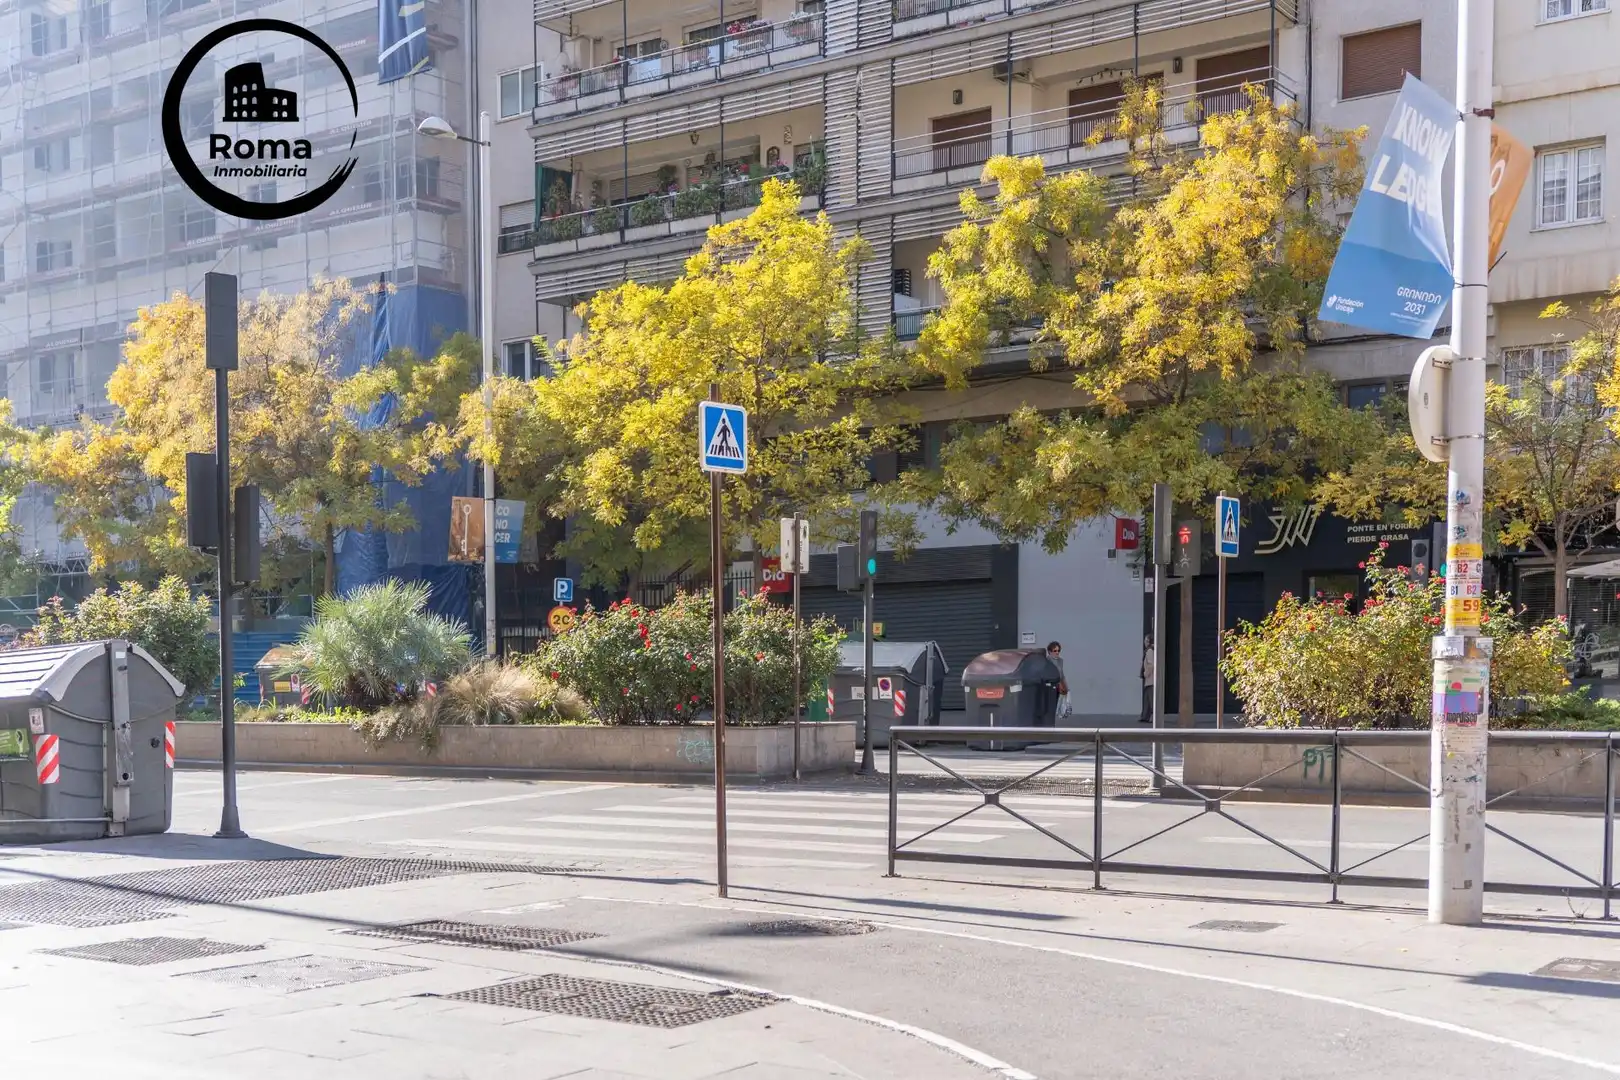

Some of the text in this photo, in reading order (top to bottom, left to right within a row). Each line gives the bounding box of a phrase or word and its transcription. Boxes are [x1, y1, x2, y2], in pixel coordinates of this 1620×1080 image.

[1396, 286, 1441, 305] GRANADA
[1404, 301, 1426, 315] 2031
[496, 506, 510, 517] CO
[495, 519, 508, 530] NO
[1347, 524, 1375, 533] PONTE
[1376, 523, 1388, 531] EN
[494, 532, 511, 544] CER
[1347, 533, 1409, 543] PIERDE GRASA
[557, 580, 569, 599] P
[1463, 599, 1480, 612] 59
[553, 614, 570, 625] 20
